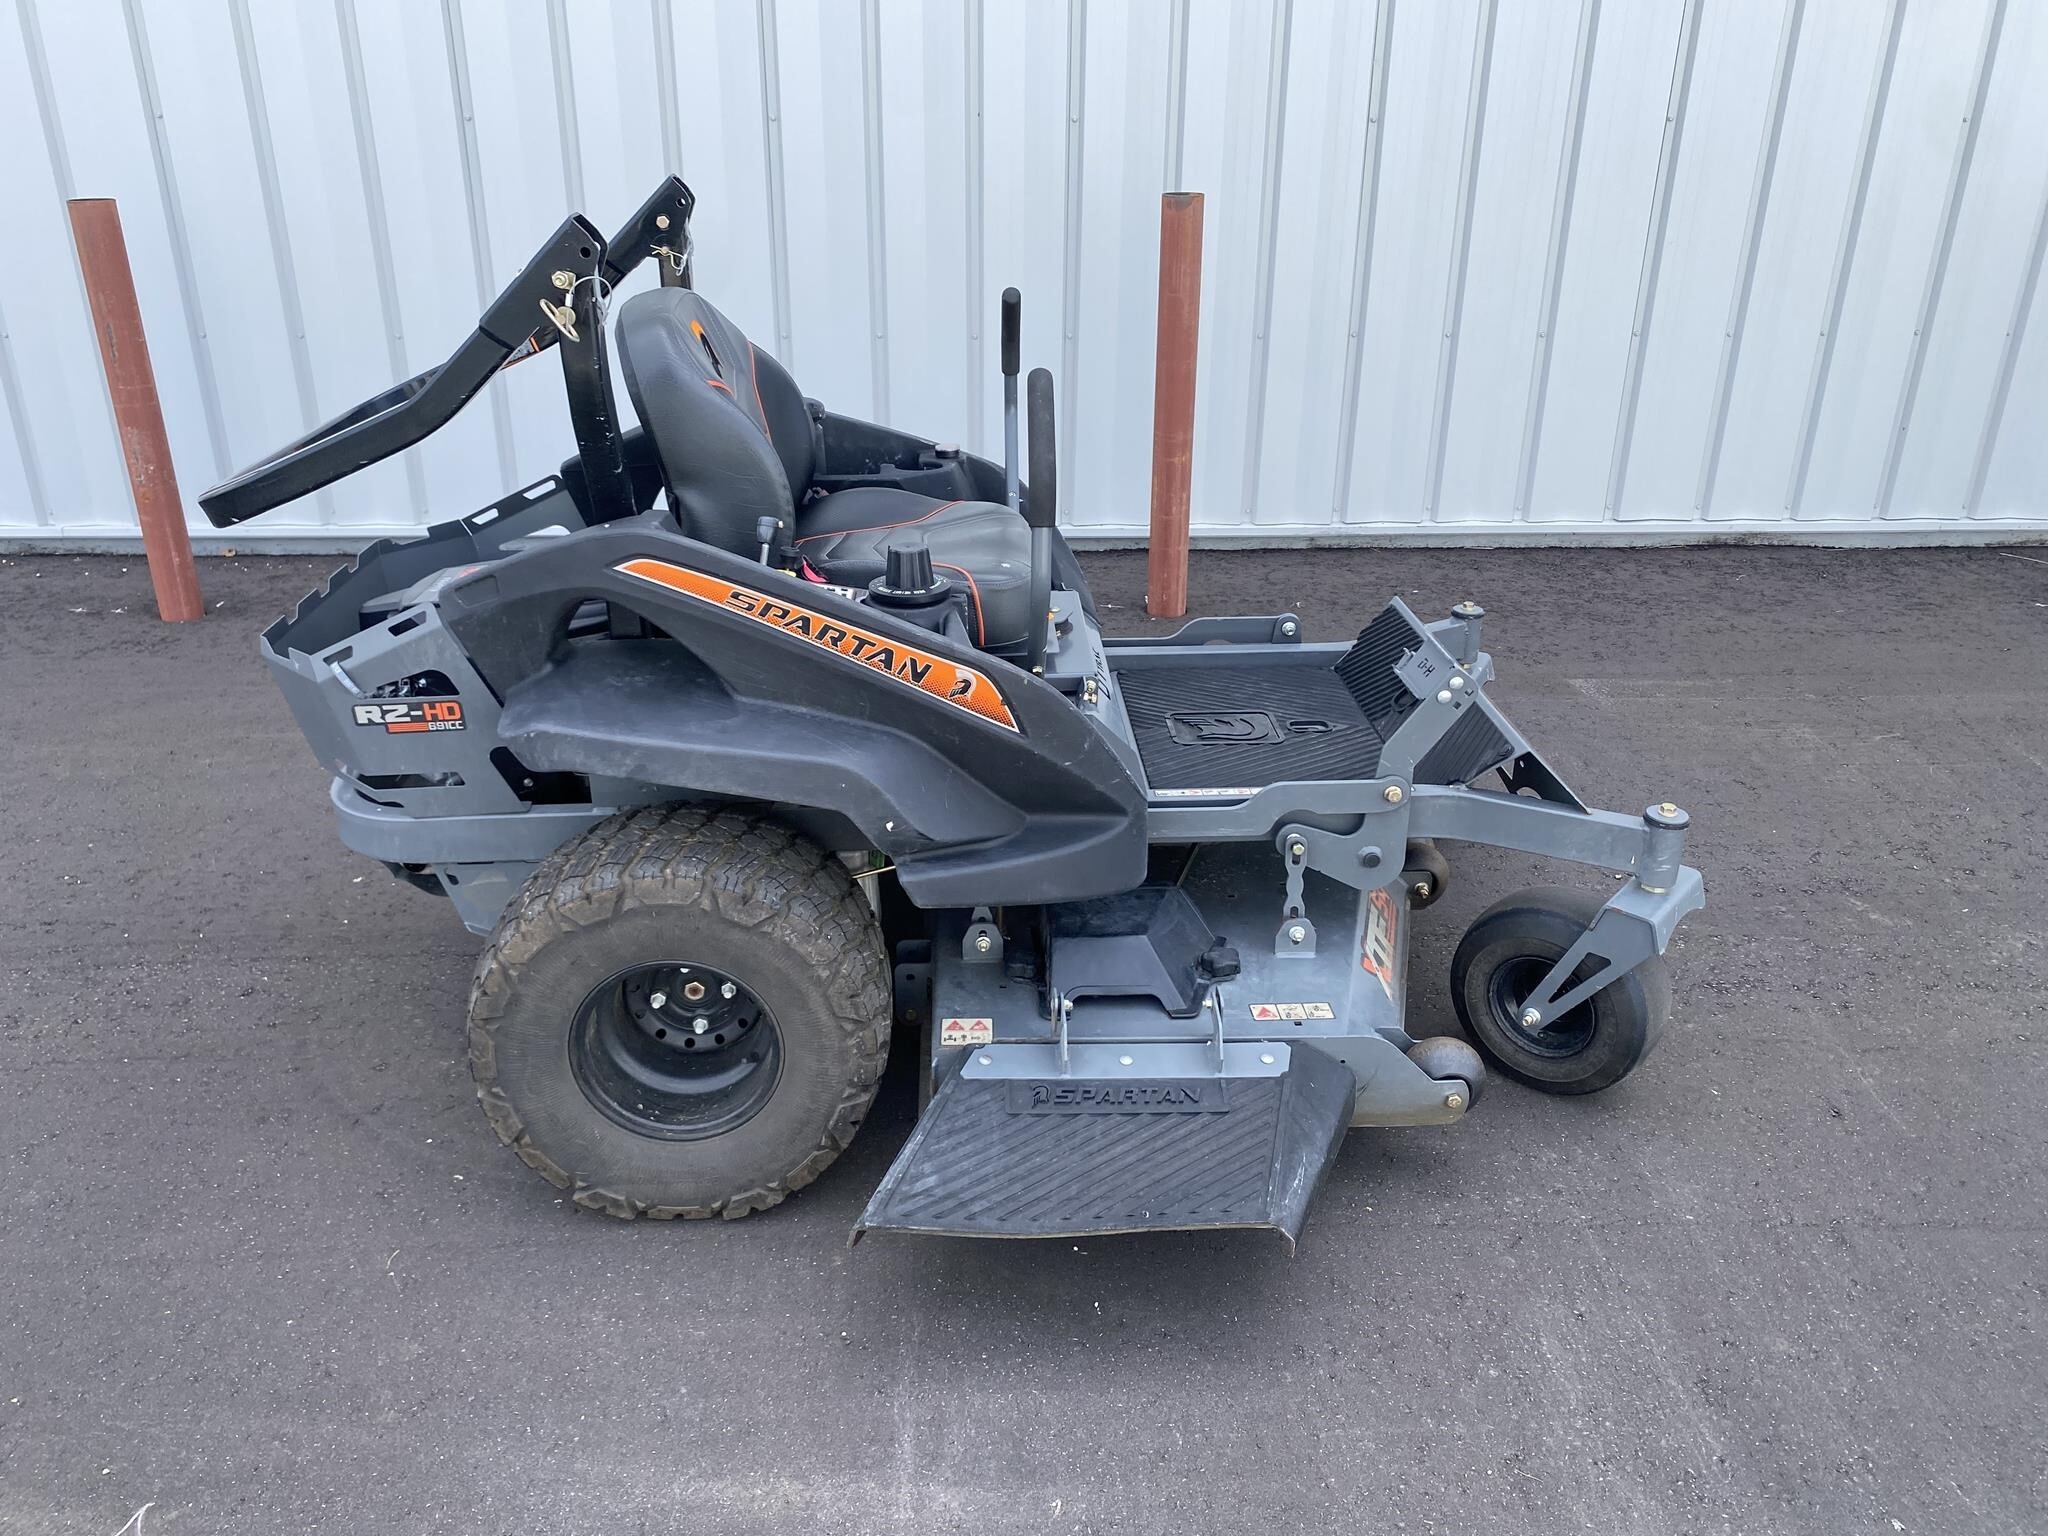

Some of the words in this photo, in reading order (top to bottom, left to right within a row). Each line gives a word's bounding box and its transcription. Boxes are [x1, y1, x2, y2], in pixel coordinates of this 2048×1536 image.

[725, 590, 932, 685] SPARTAN
[354, 702, 461, 724] RZ-HD
[428, 721, 464, 730] 691CC
[1054, 1087, 1201, 1104] SPARTAN
